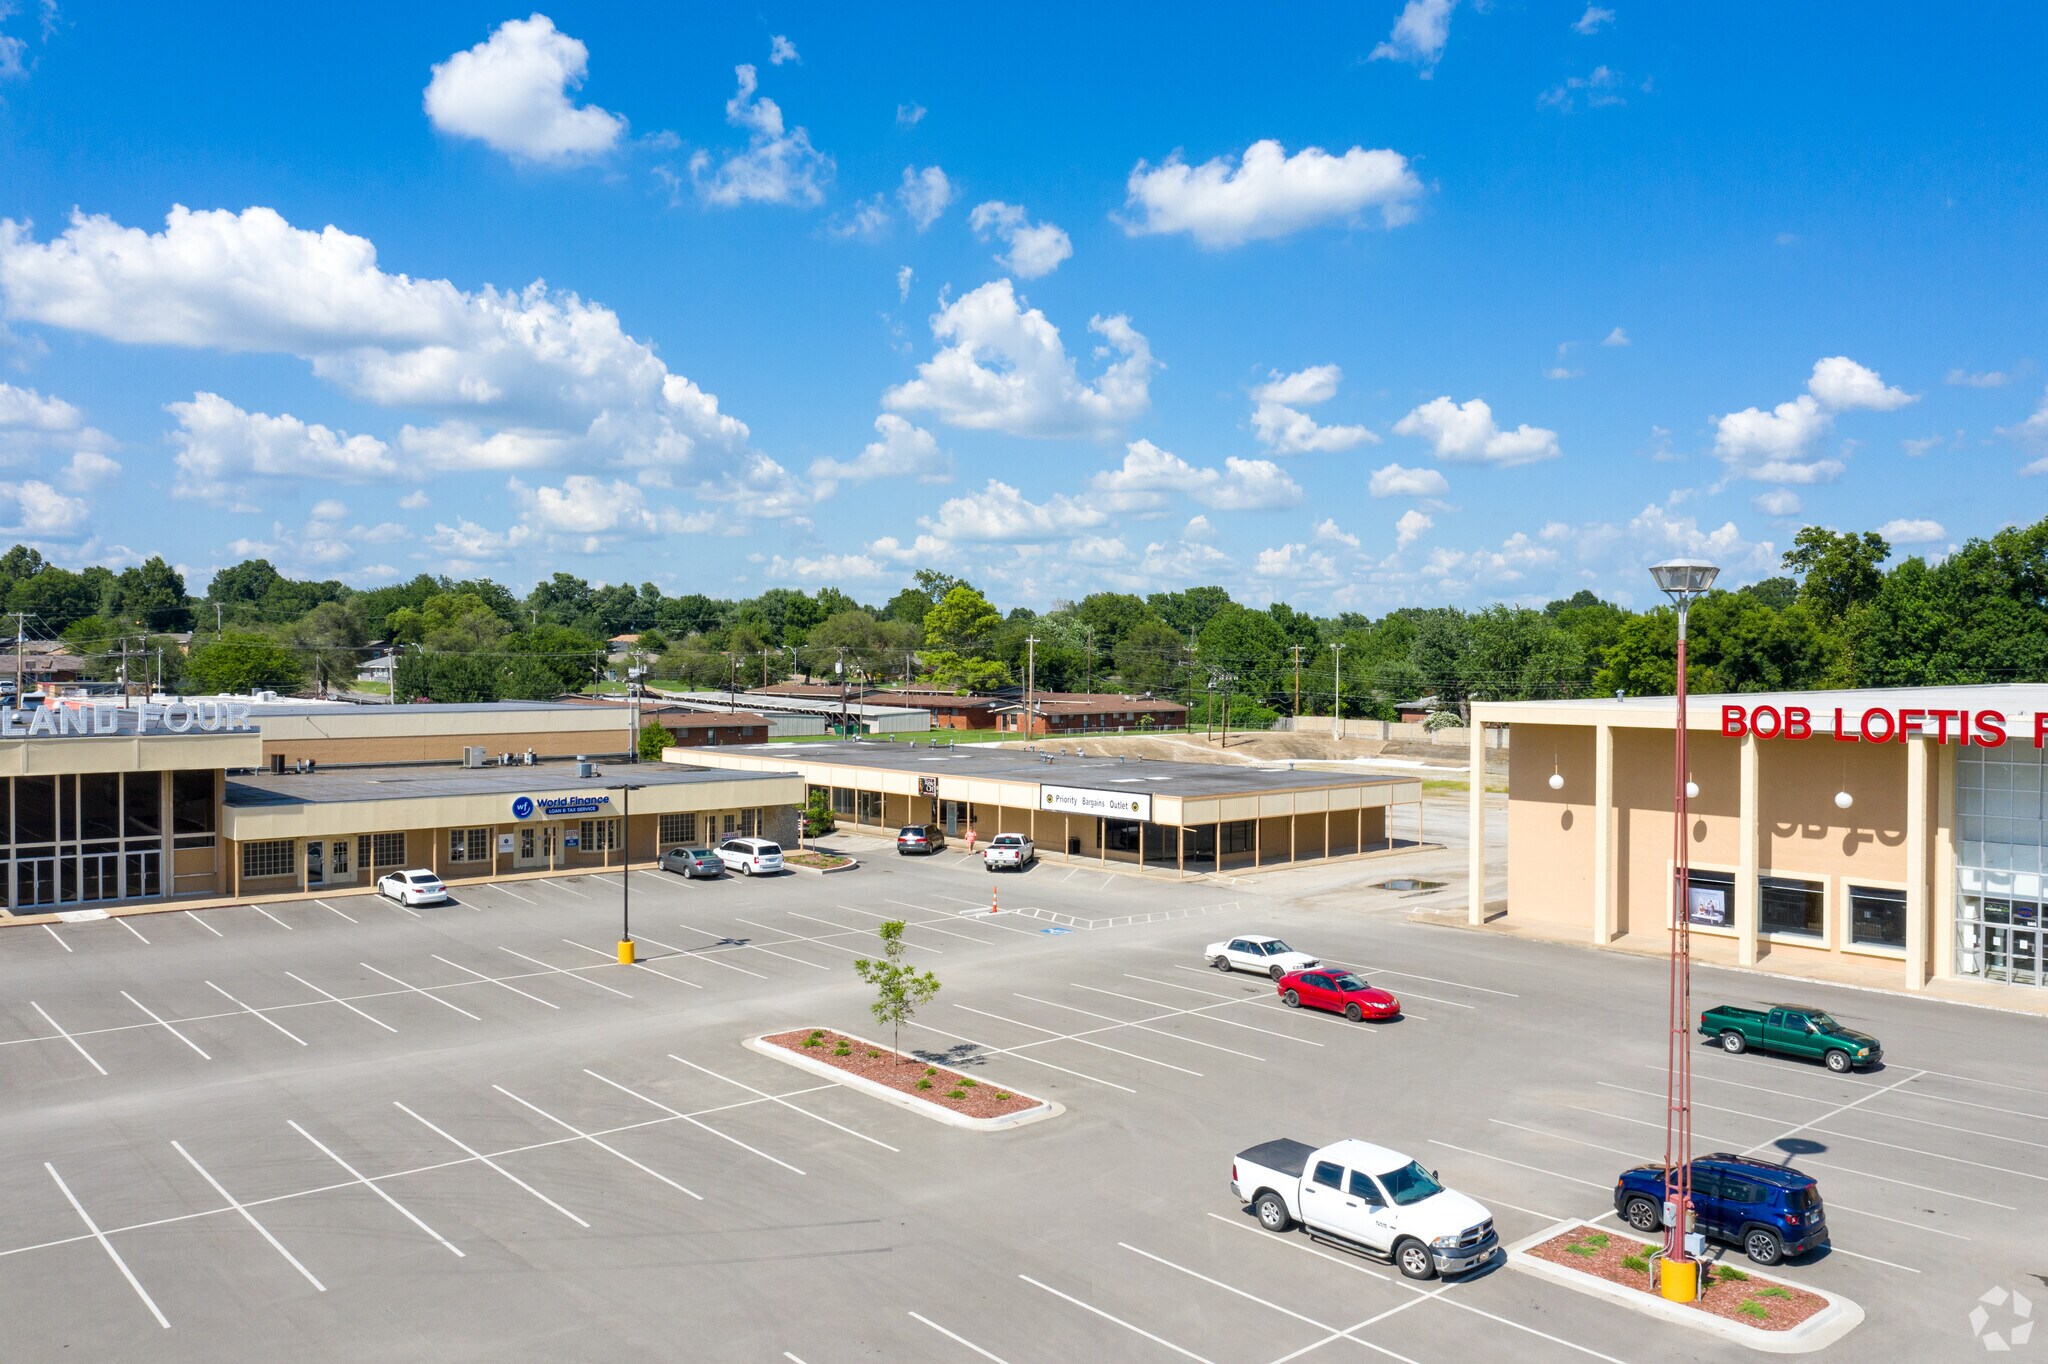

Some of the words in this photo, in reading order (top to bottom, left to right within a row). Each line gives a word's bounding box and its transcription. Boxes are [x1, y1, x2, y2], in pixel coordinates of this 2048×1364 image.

[2, 704, 118, 736] LAND
[138, 702, 250, 733] FOUR
[1721, 705, 1813, 740] BOB
[1834, 707, 2008, 748] LOFTIS
[536, 797, 568, 808] World
[569, 795, 610, 806] Finance
[1055, 794, 1078, 806] Priority
[1081, 796, 1105, 809] Bargains
[1109, 799, 1129, 811] Outlet
